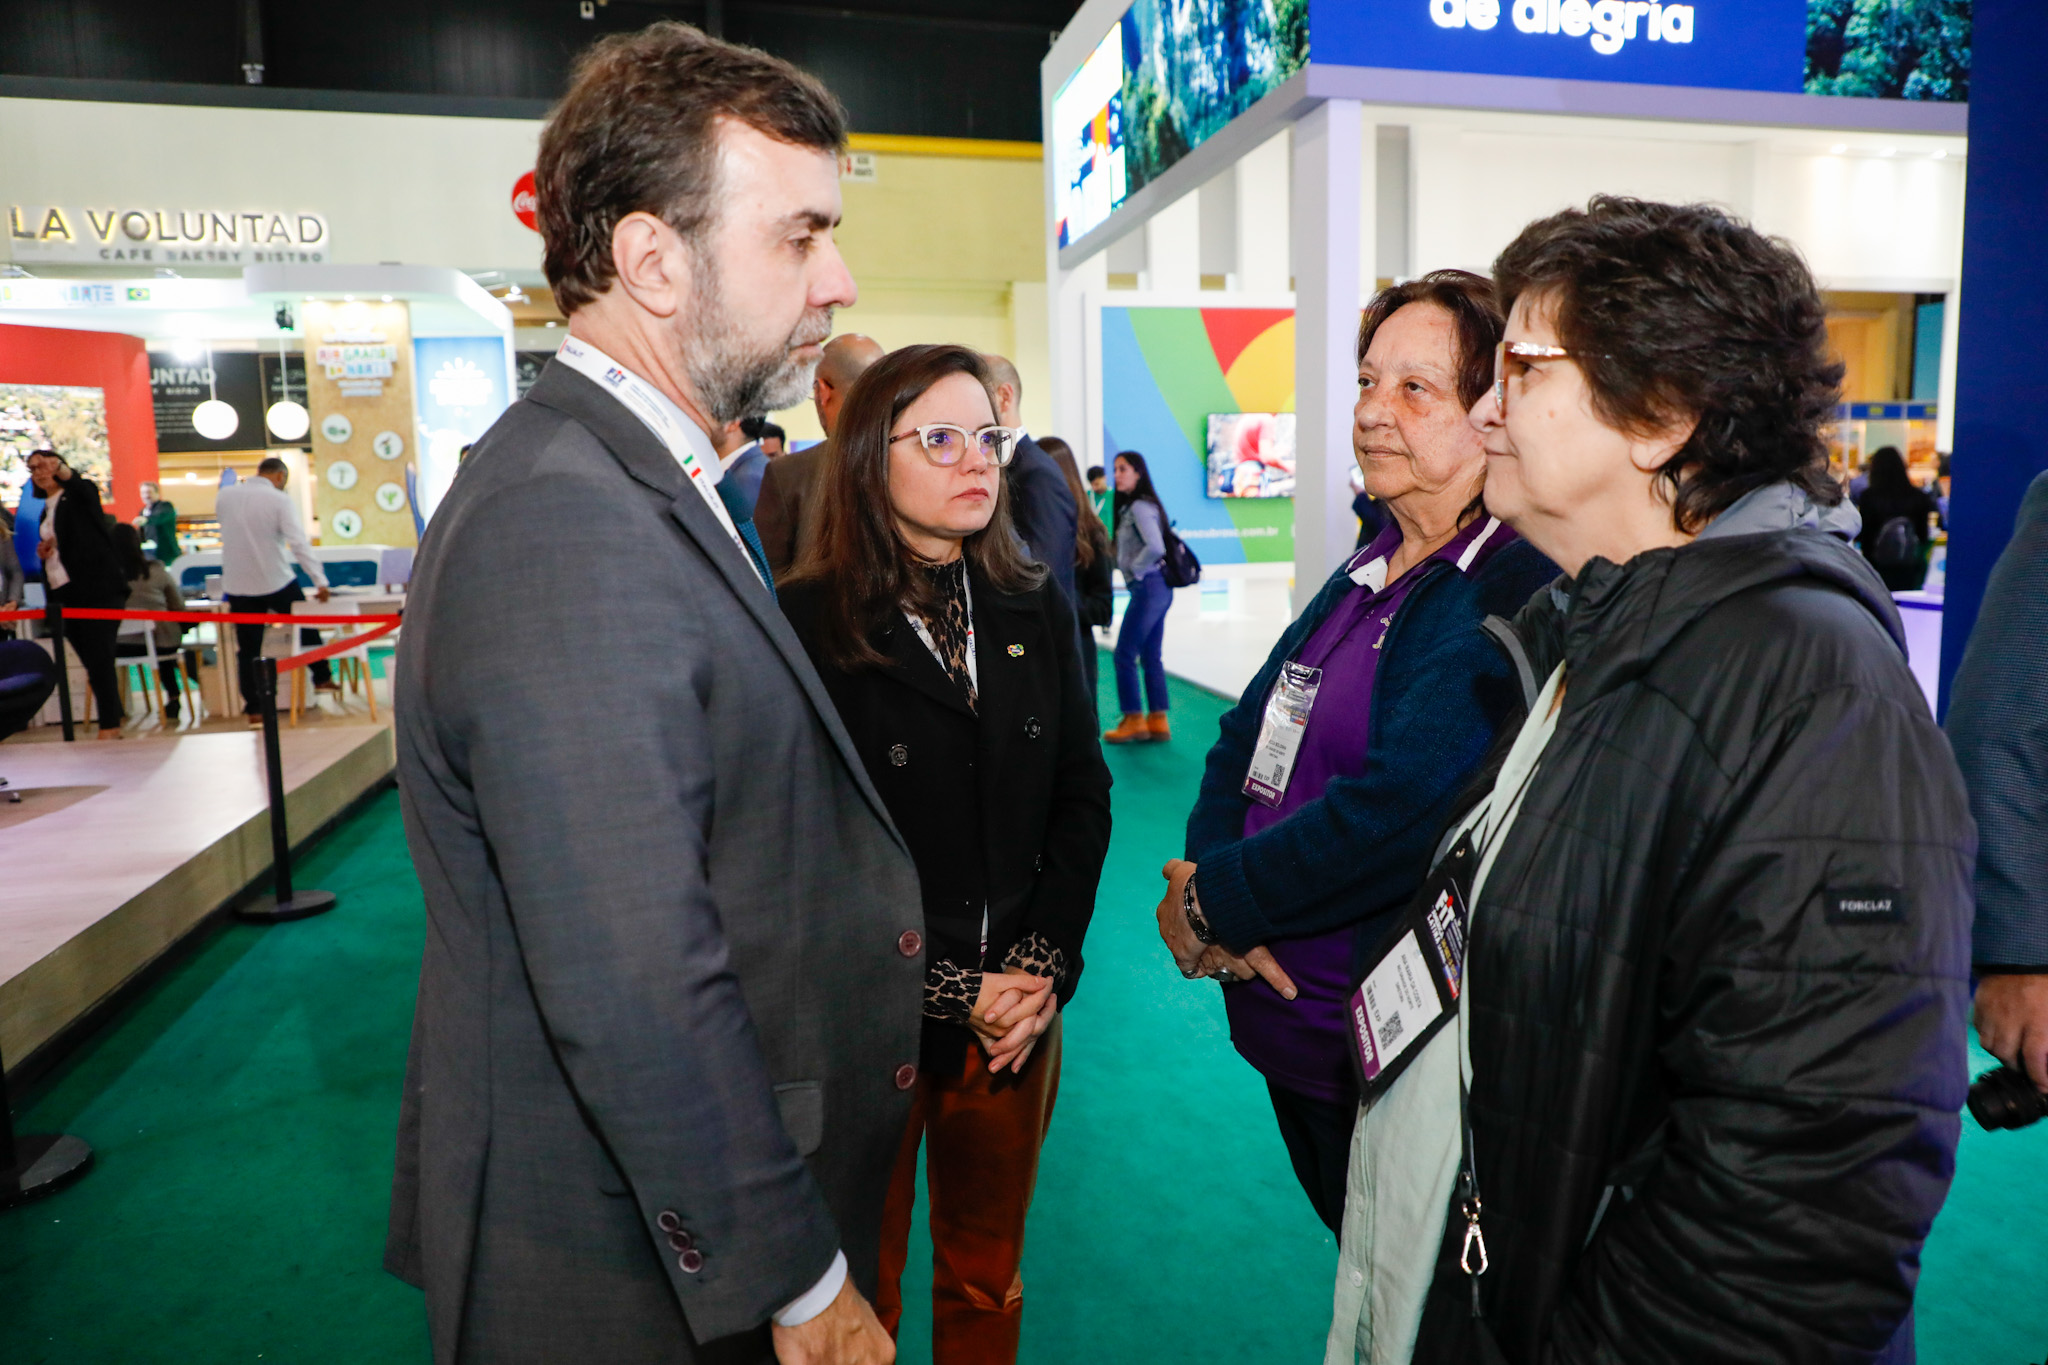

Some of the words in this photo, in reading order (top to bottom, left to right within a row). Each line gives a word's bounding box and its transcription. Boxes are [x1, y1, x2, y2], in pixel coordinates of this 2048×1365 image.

[10, 207, 71, 239] LA
[86, 210, 323, 244] VOLUNTAD
[100, 249, 152, 260] CAFE
[255, 252, 322, 263] BISTRO
[149, 367, 217, 385] UNTAD
[1251, 782, 1276, 800] EXPOSITOR
[1427, 913, 1441, 944] LATINA
[1355, 1004, 1374, 1064] EXPOSITOR
